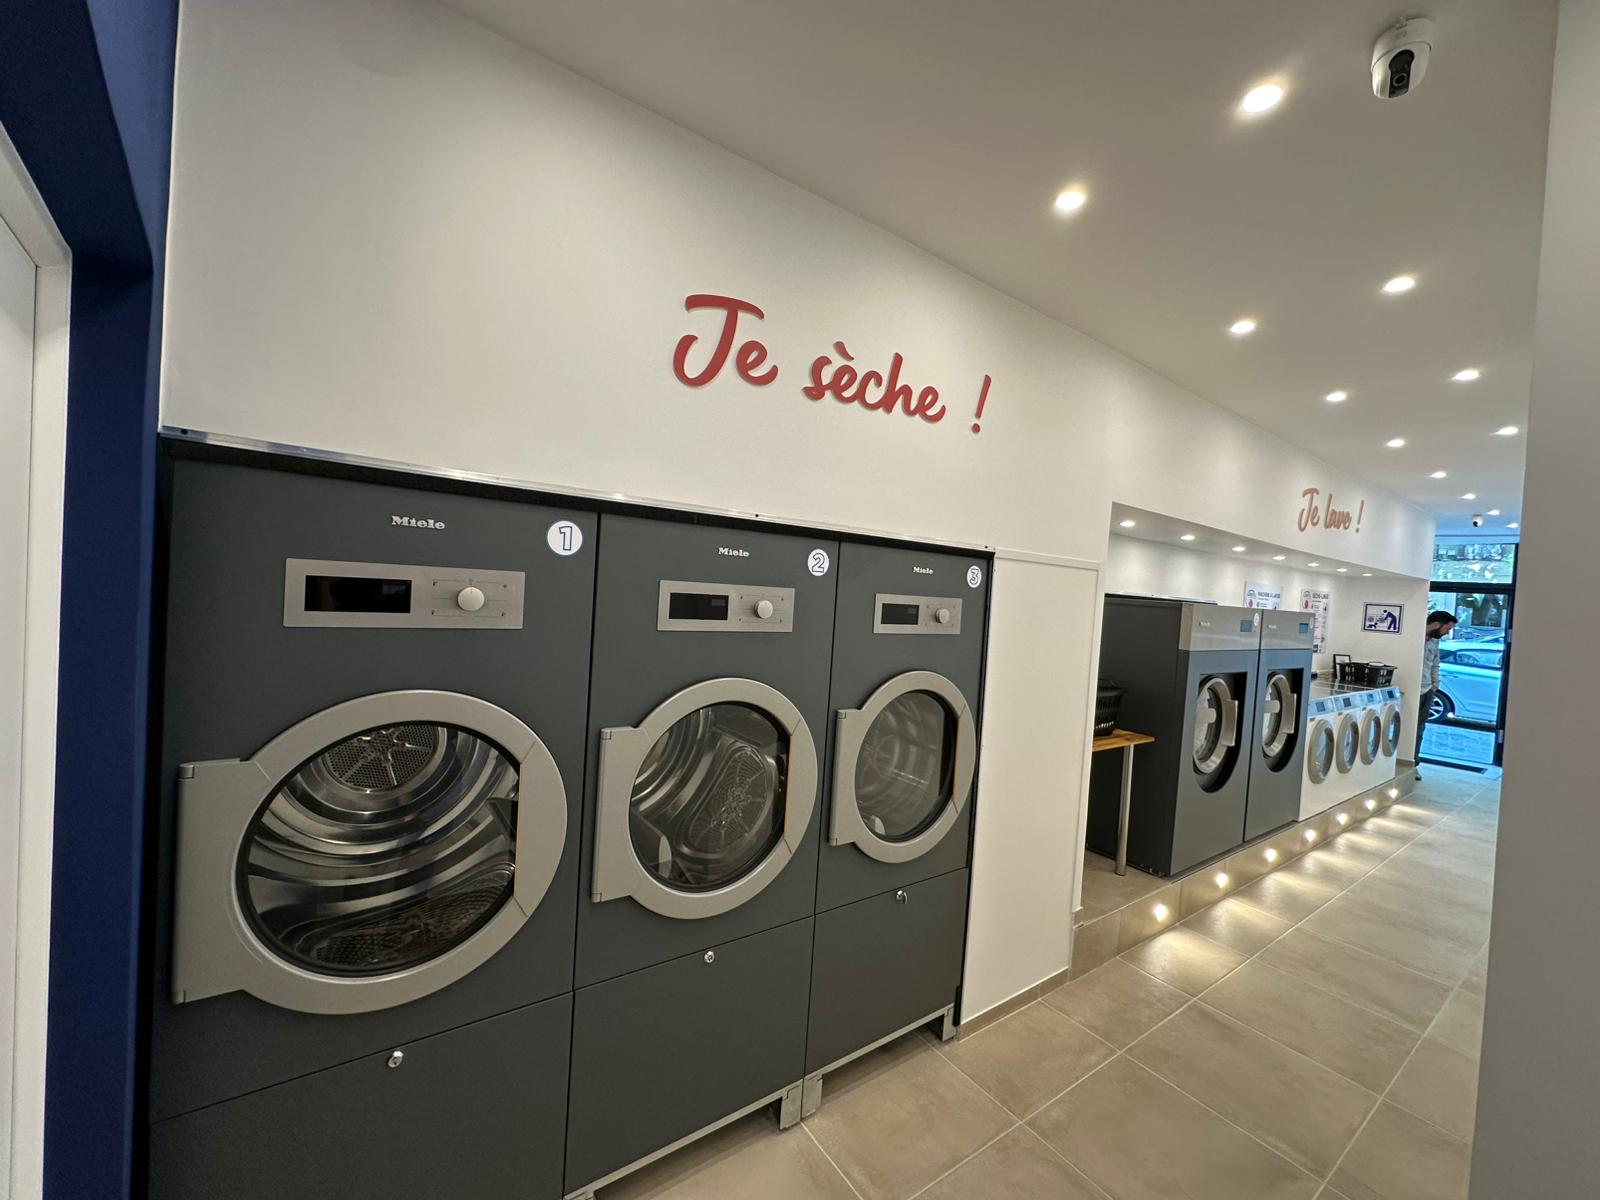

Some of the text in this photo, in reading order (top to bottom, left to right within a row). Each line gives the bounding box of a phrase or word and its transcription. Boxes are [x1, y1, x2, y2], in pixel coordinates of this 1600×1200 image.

[673, 293, 992, 434] Je sèche !
[1298, 487, 1365, 533] Je lave !
[391, 515, 446, 530] Miele
[558, 525, 573, 551] 1
[718, 547, 750, 558] Miele
[811, 552, 826, 573] 2
[913, 566, 934, 575] Miele
[968, 567, 980, 586] 3
